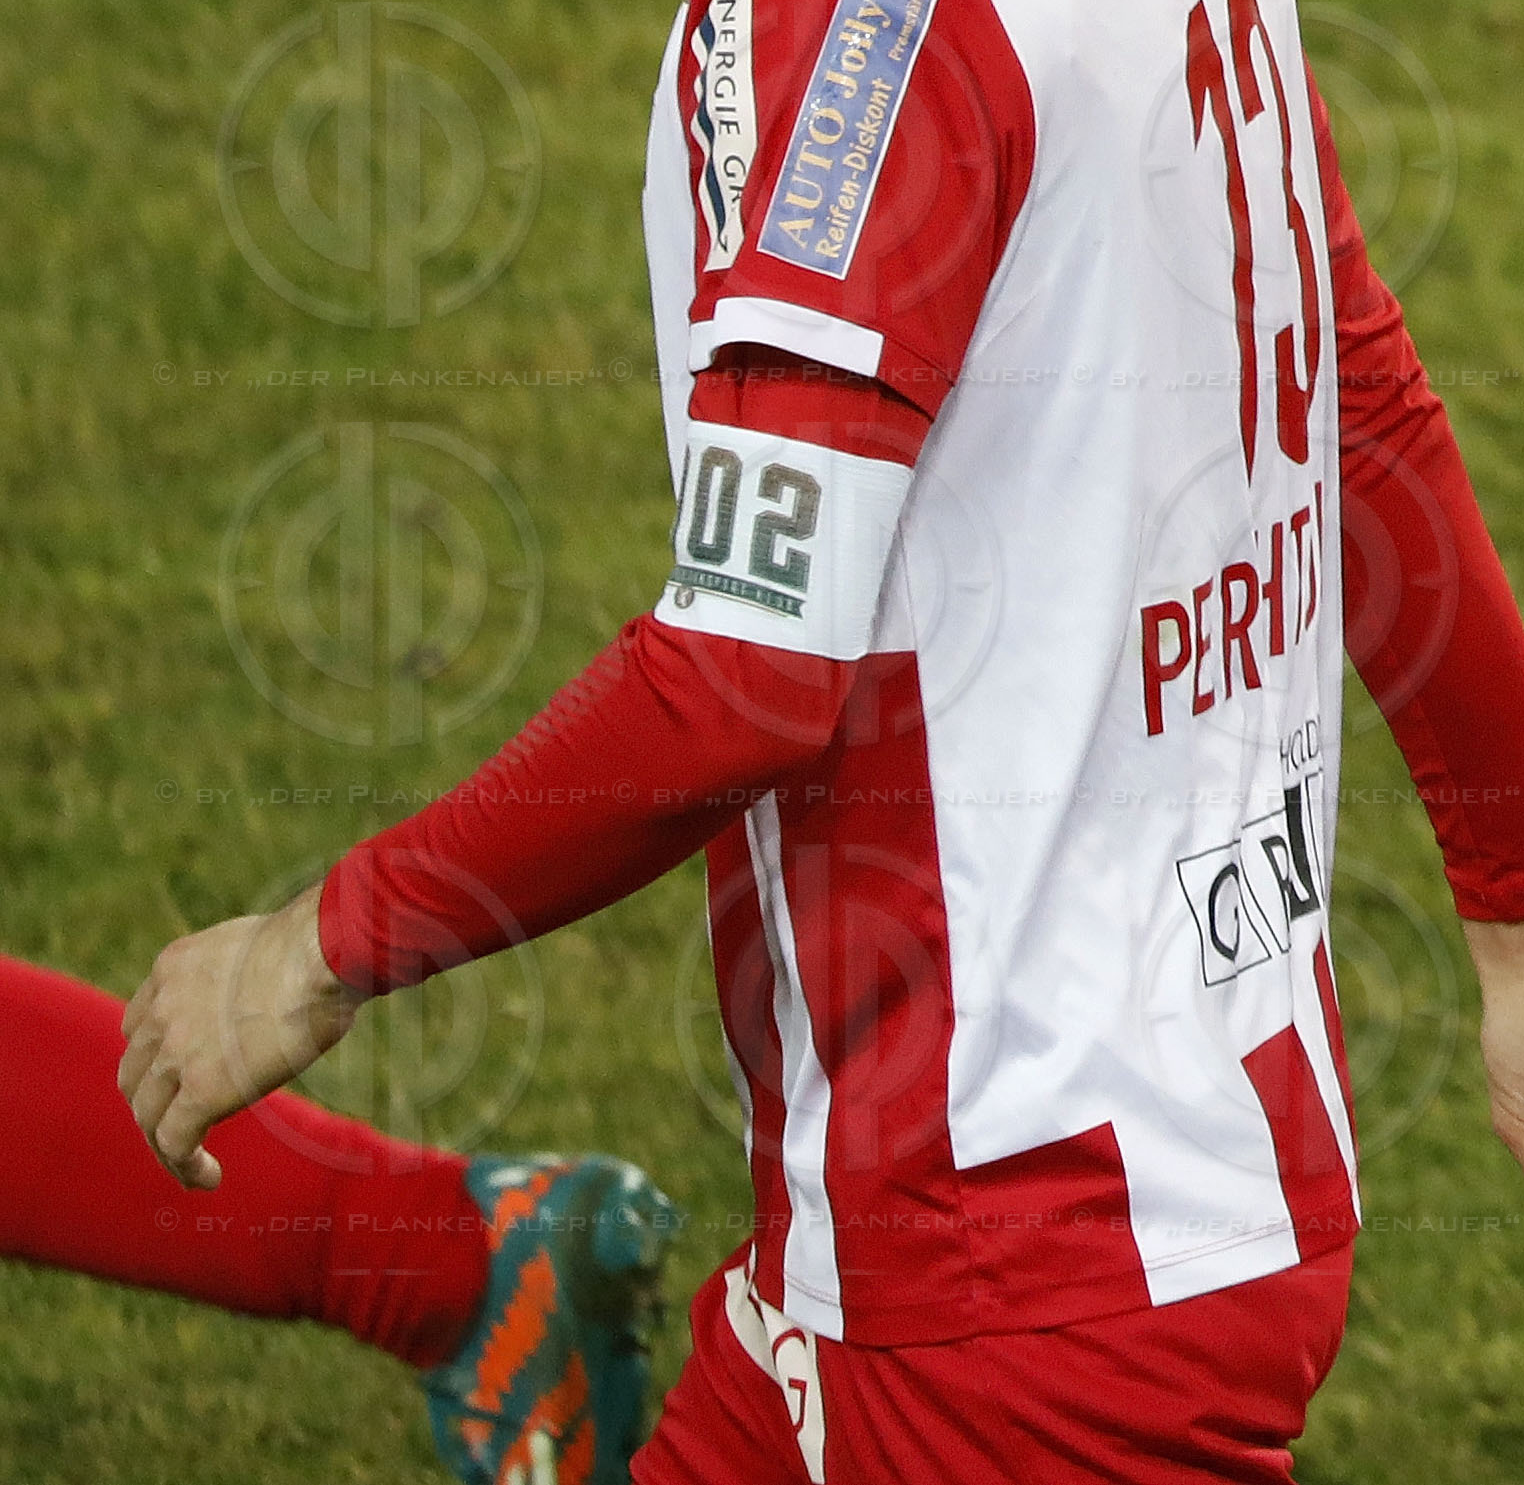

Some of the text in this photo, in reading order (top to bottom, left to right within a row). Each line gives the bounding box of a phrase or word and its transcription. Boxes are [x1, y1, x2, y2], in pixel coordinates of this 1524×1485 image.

[778, 106, 845, 249] AUTO
[815, 77, 894, 259] Reifen-Diskont
[676, 444, 822, 593] 02
